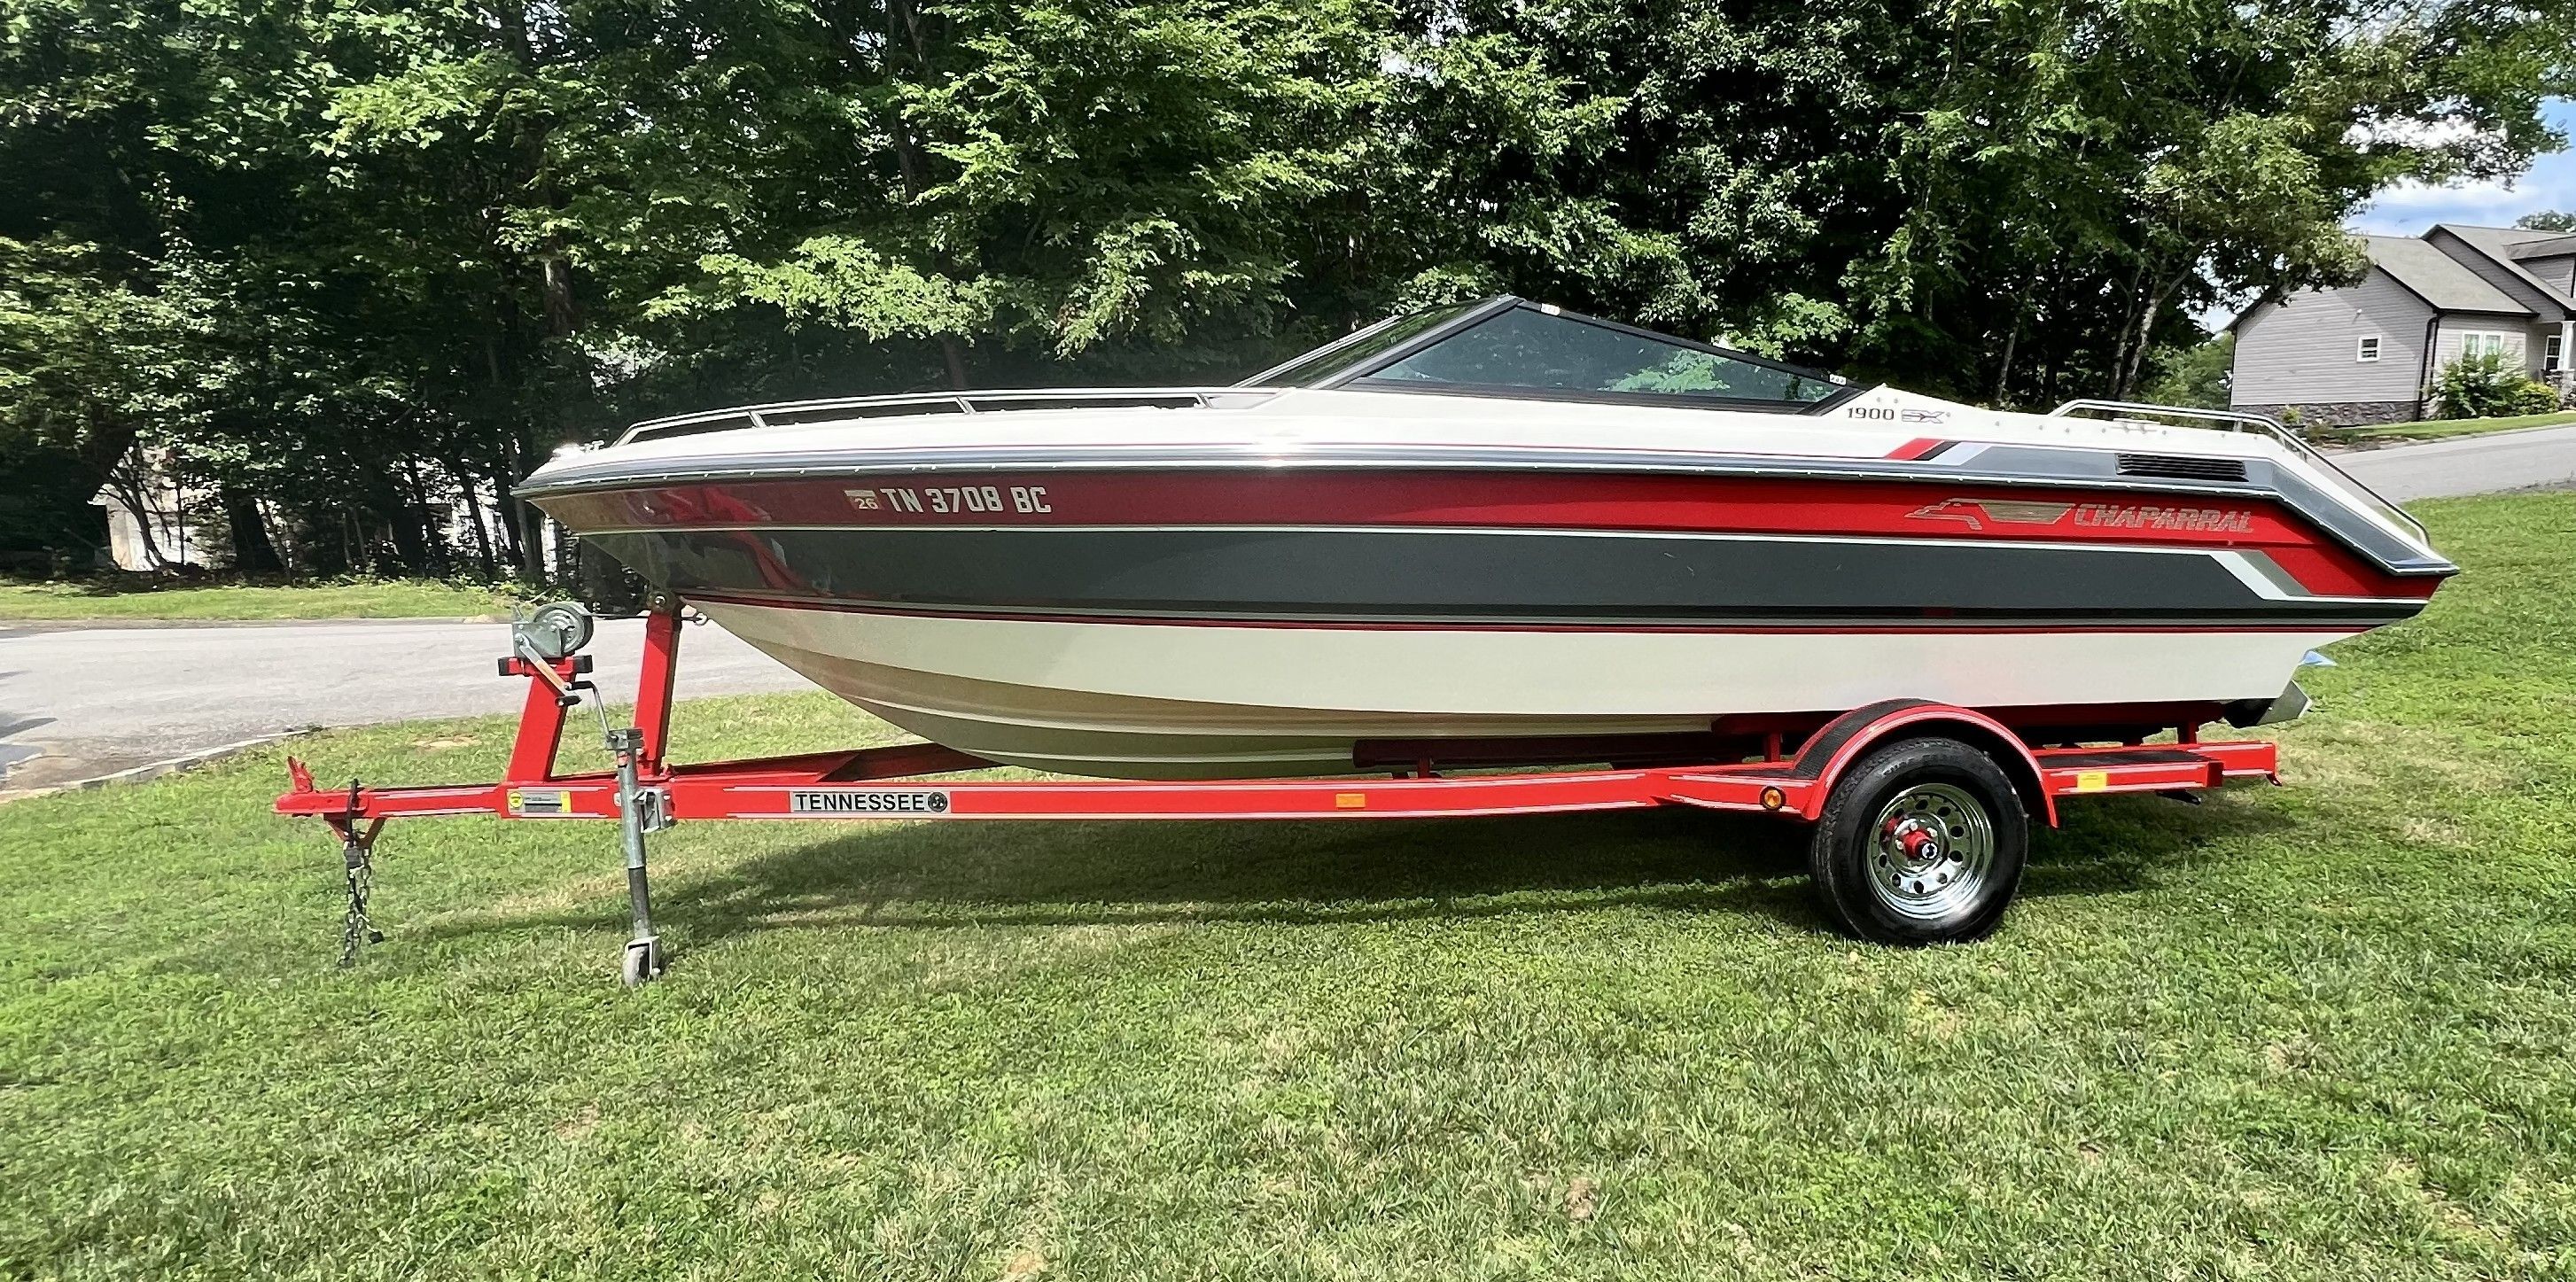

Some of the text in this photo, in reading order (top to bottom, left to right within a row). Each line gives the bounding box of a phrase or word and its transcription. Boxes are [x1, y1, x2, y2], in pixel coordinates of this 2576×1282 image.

[1847, 408, 1895, 421] 1900
[854, 498, 879, 509] 26
[880, 486, 1052, 513] TN 3708 BC
[2074, 503, 2253, 533] CHAPARRAL
[795, 794, 925, 811] TENNESSEE
